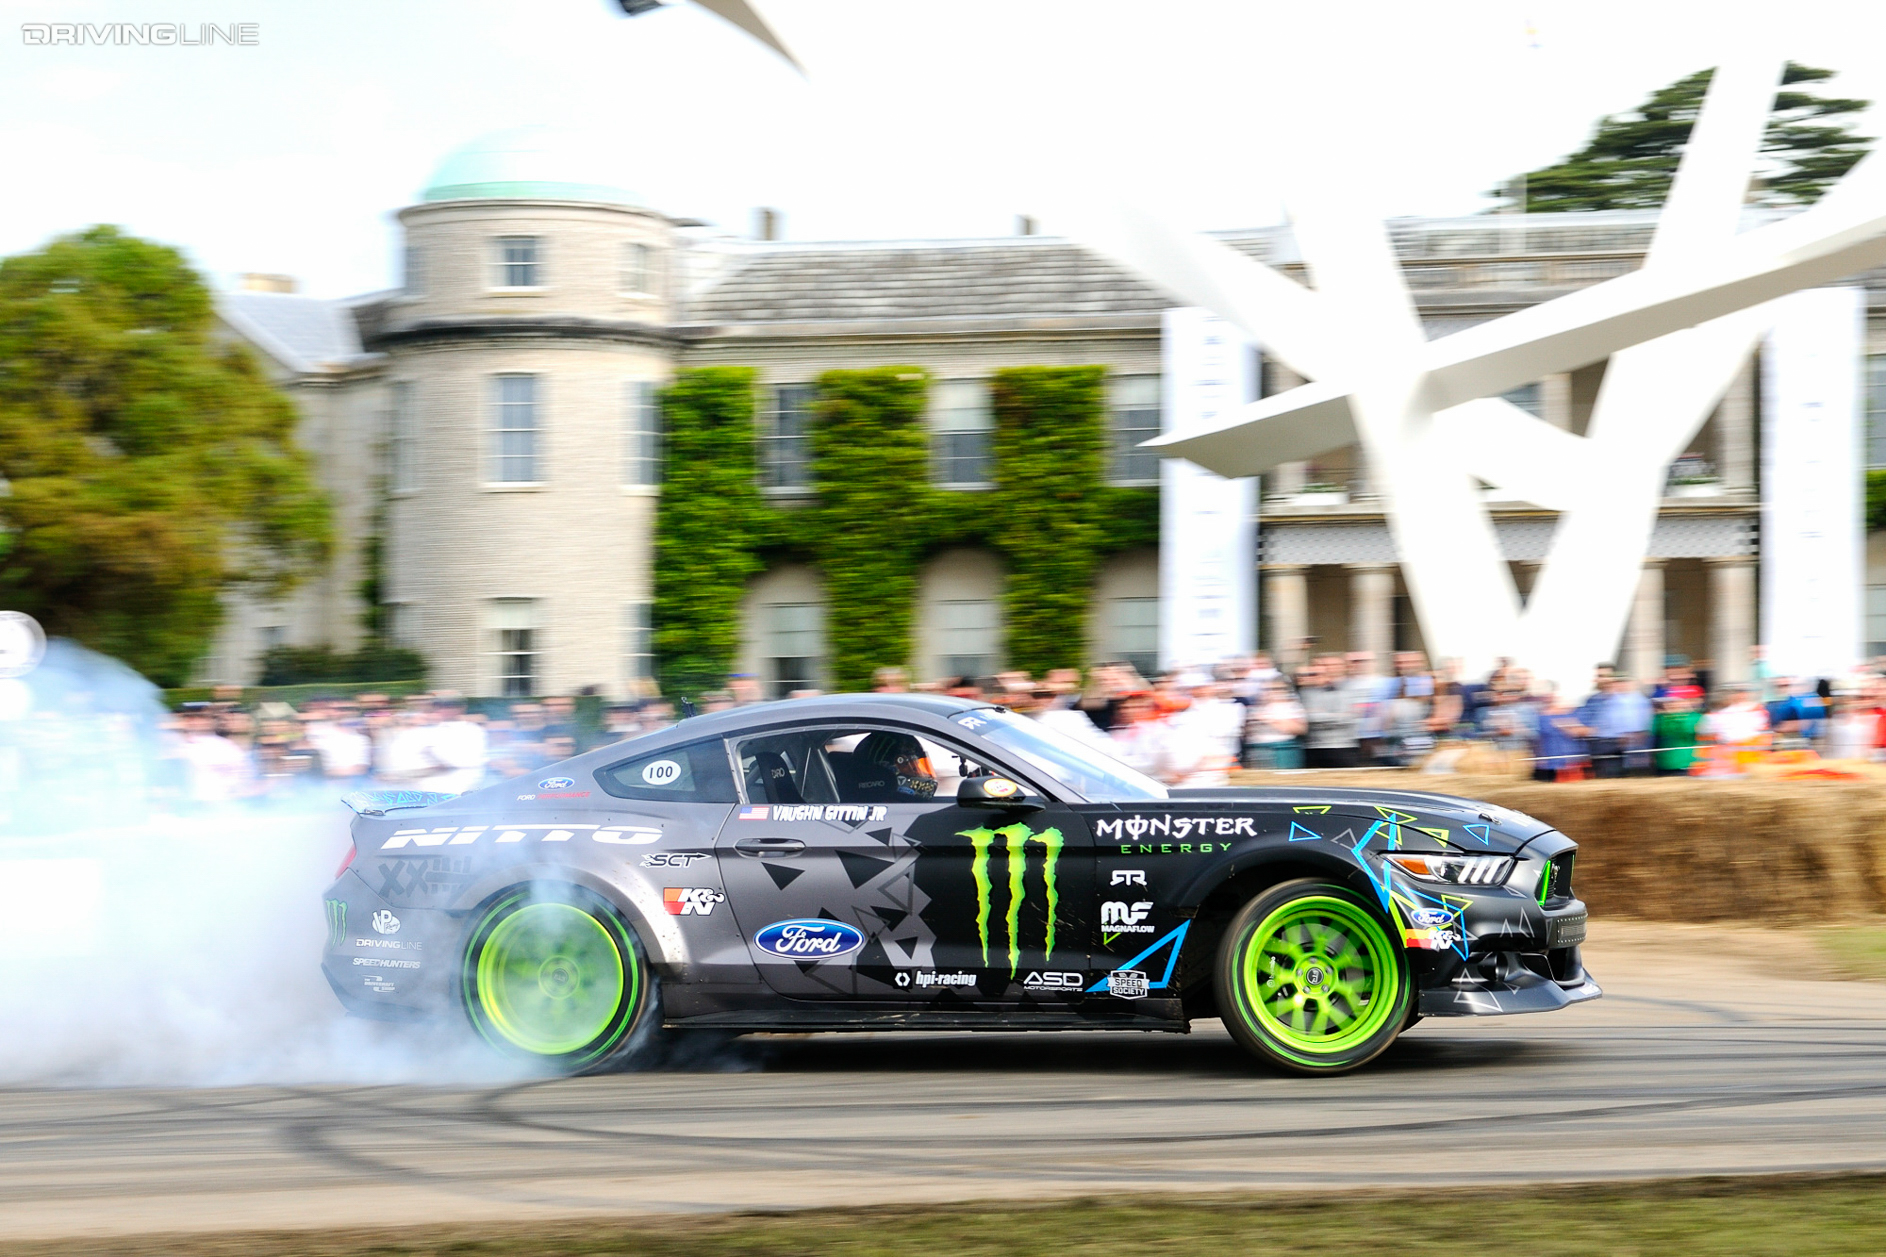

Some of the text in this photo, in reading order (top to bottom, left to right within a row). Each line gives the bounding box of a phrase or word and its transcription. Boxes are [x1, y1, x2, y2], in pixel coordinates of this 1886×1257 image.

[649, 765, 674, 779] 100
[516, 793, 537, 801] FORD
[773, 804, 888, 822] VAUGHN GITTIN JR
[381, 823, 663, 850] NITTO
[1120, 842, 1232, 854] ENERGY
[648, 853, 702, 868] SCT
[1101, 924, 1155, 934] MAGNAFLOW
[1023, 971, 1084, 987] ASD
[1115, 978, 1142, 987] SPEED
[1113, 987, 1145, 995] SOCIETY
